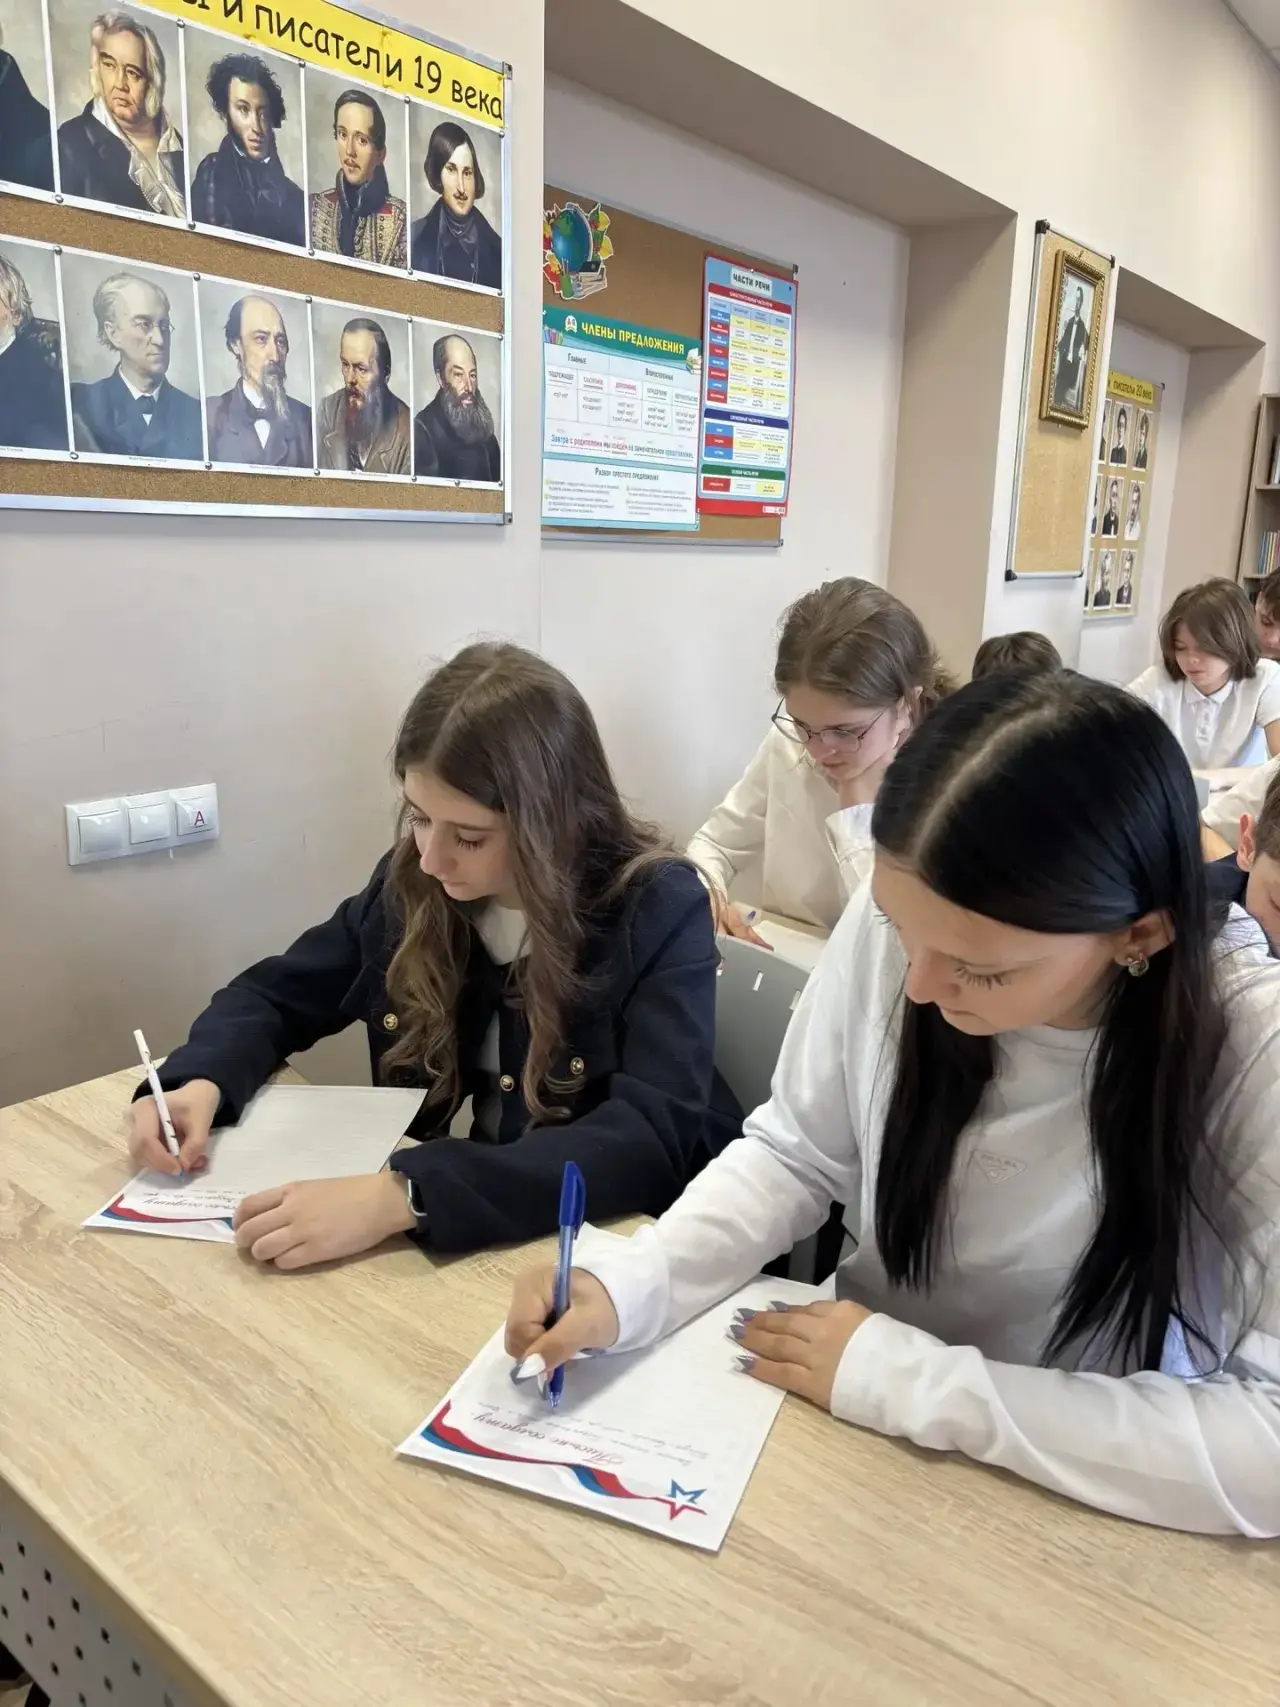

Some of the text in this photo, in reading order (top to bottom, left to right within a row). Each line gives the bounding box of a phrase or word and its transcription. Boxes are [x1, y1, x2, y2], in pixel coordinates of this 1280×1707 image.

[255, 4, 403, 82] писатели
[414, 56, 443, 94] 19
[452, 80, 503, 121] века
[732, 273, 771, 292] ЧАСТИ РЕЧИ
[581, 322, 685, 355] ЧЛЕНЫ ПРЕДЛОЖЕНИЯ
